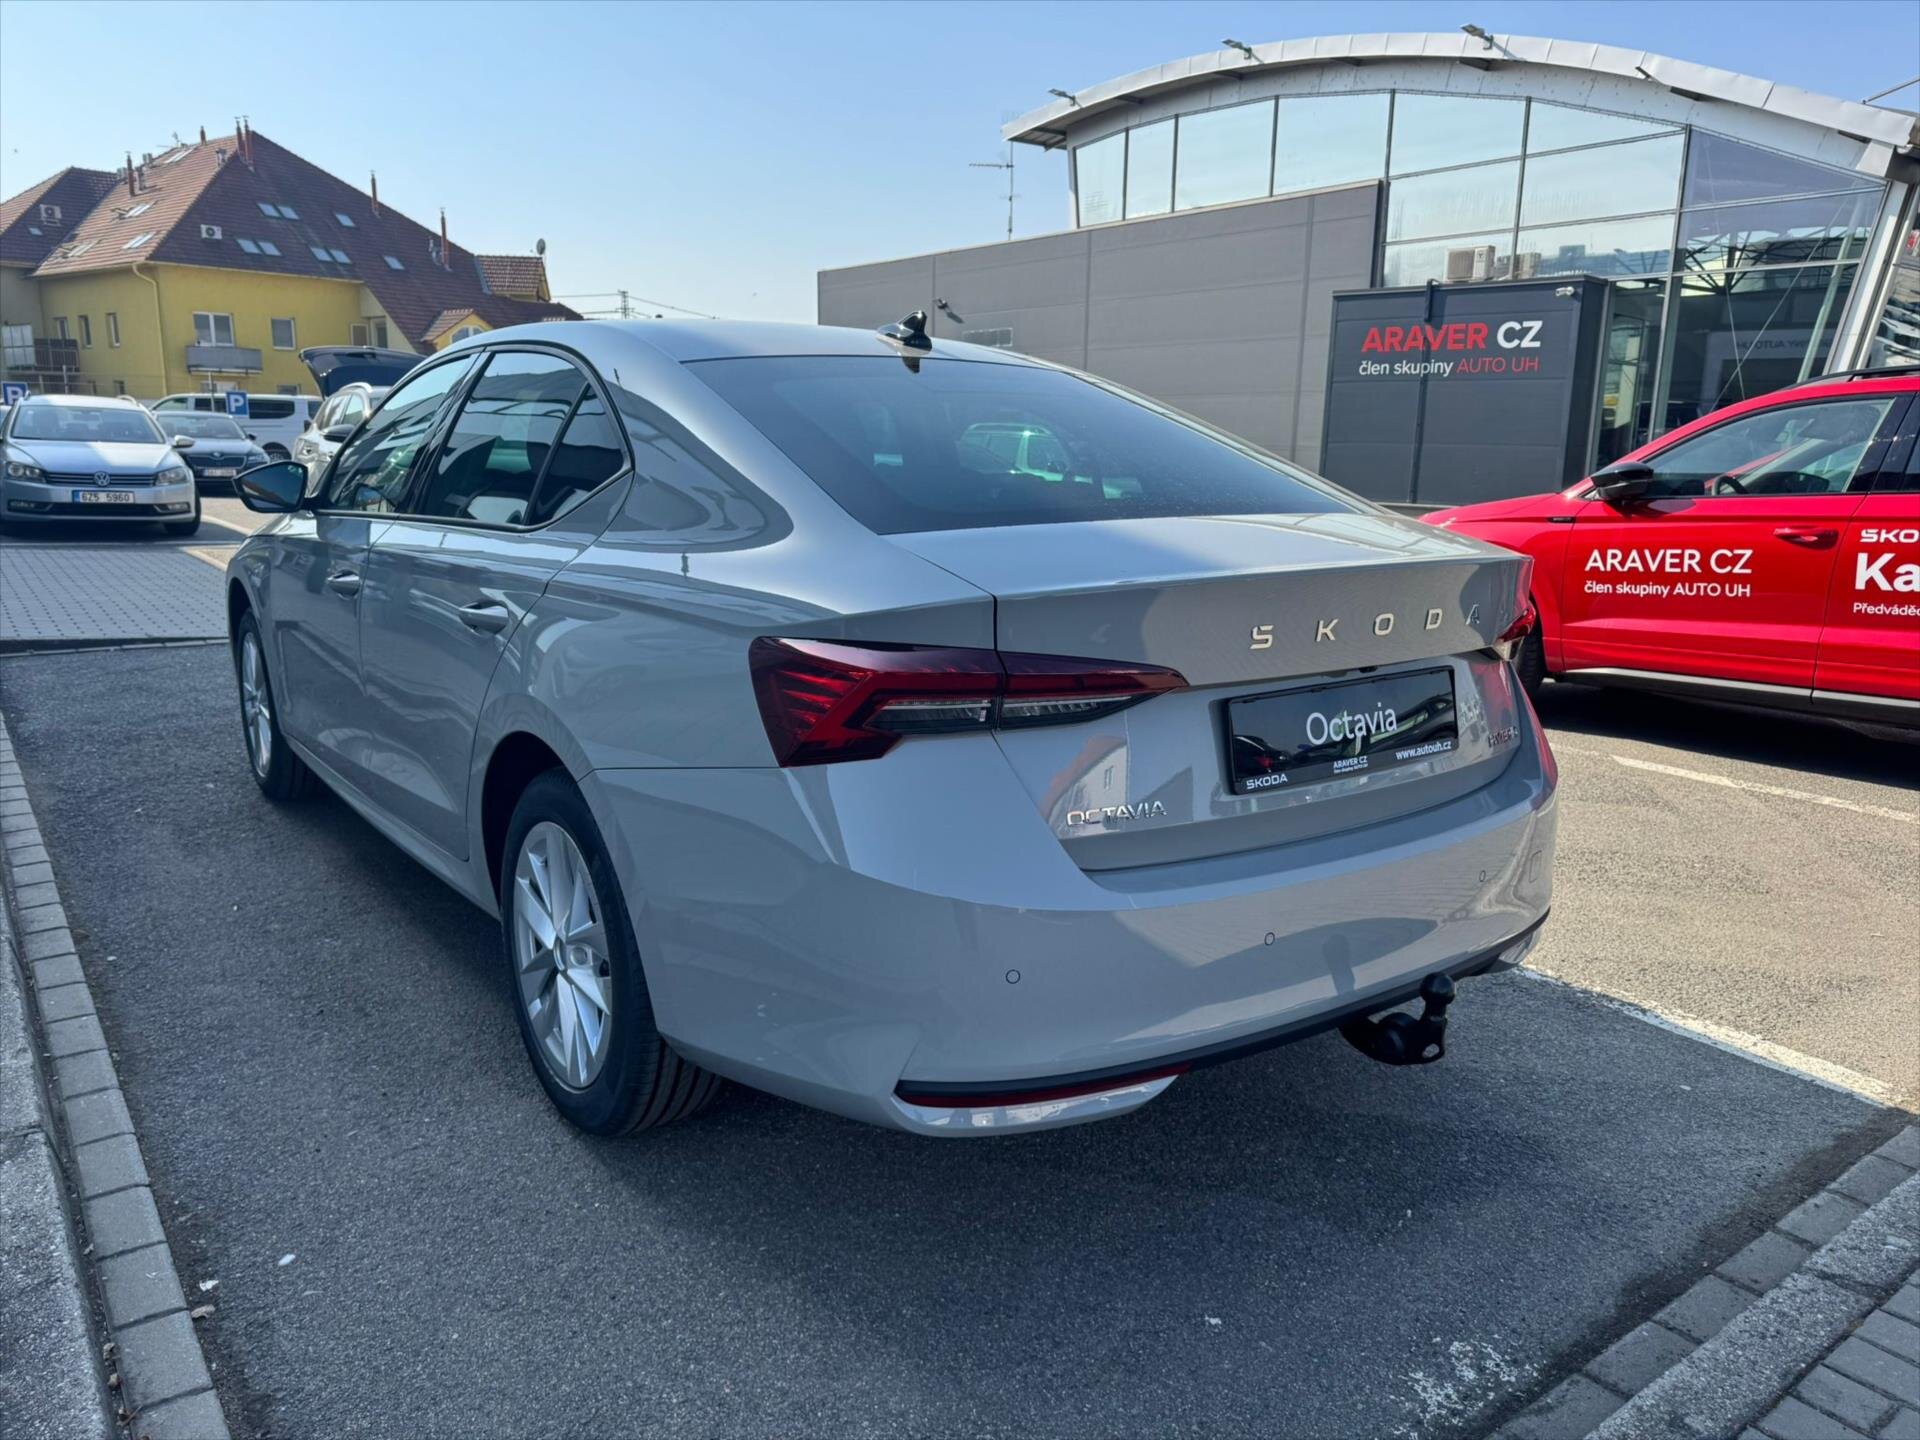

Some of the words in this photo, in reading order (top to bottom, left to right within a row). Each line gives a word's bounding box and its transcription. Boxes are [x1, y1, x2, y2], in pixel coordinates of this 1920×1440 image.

[1361, 322, 1488, 352] ARAVER
[1496, 320, 1544, 349] CZ
[1358, 360, 1389, 376] člen
[1393, 359, 1454, 377] skupiny
[1456, 357, 1507, 373] AUTO
[1511, 356, 1540, 373] UH
[6, 386, 24, 405] P
[230, 394, 244, 412] P
[1860, 528, 1920, 543] SKO
[1584, 549, 1702, 573] ARAVER
[1709, 549, 1753, 574] CZ
[1855, 552, 1920, 592] Ka
[1584, 580, 1612, 593] člen
[1615, 581, 1670, 598] skupiny
[1673, 583, 1721, 596] AUTO
[1725, 584, 1750, 597] UH
[1250, 603, 1481, 650] SKODA
[1306, 702, 1398, 746] Octavia
[1395, 740, 1452, 760] www.autouh.cz
[1333, 757, 1358, 769] ARAVER
[1358, 755, 1368, 764] CZ
[1246, 773, 1288, 790] SKODA
[1066, 800, 1168, 825] OCTAVIA
